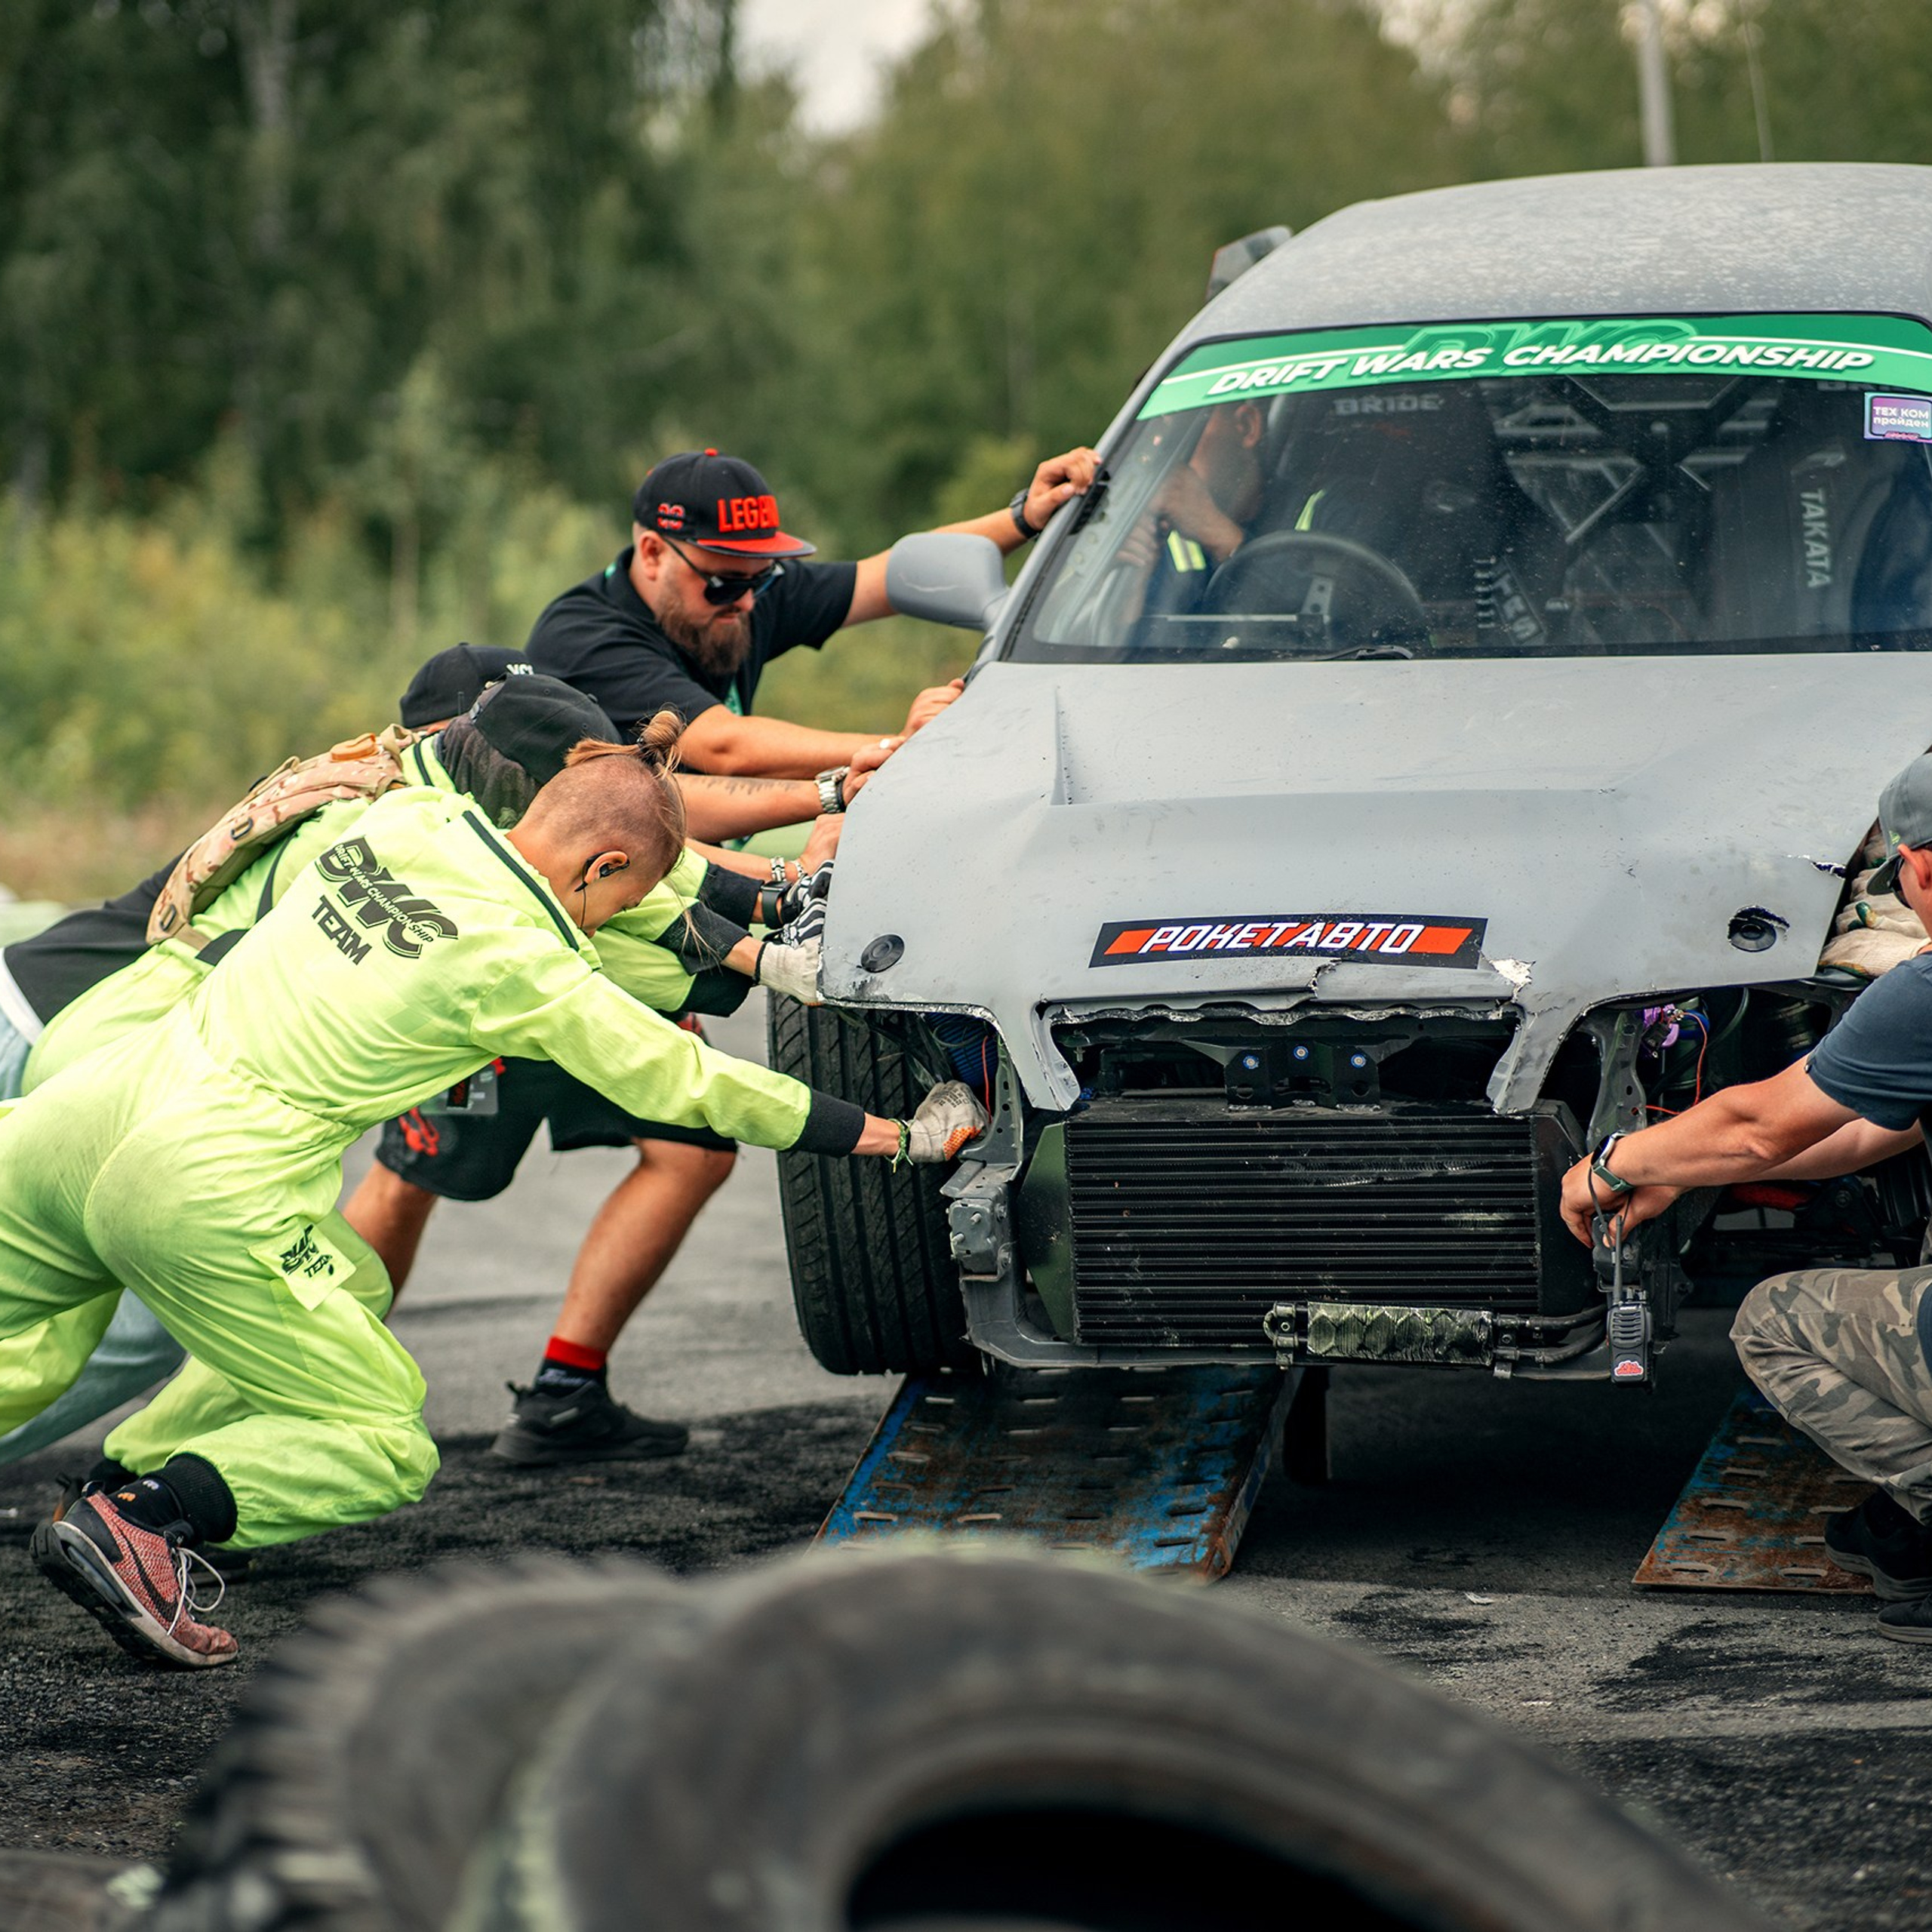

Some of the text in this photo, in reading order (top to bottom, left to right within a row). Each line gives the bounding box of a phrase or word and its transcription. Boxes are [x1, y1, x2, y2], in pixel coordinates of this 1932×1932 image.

[1208, 343, 1874, 395] DRIFT WARS CHAMPIONSHIP
[1334, 394, 1441, 416] BRIDE
[1873, 406, 1929, 420] ТЕХ КОМ
[1873, 417, 1929, 428] пройден
[1800, 488, 1832, 588] TAKATA
[334, 844, 434, 943] DRIFT WARS CHAMPIONSHIP
[312, 894, 373, 965] TEAM
